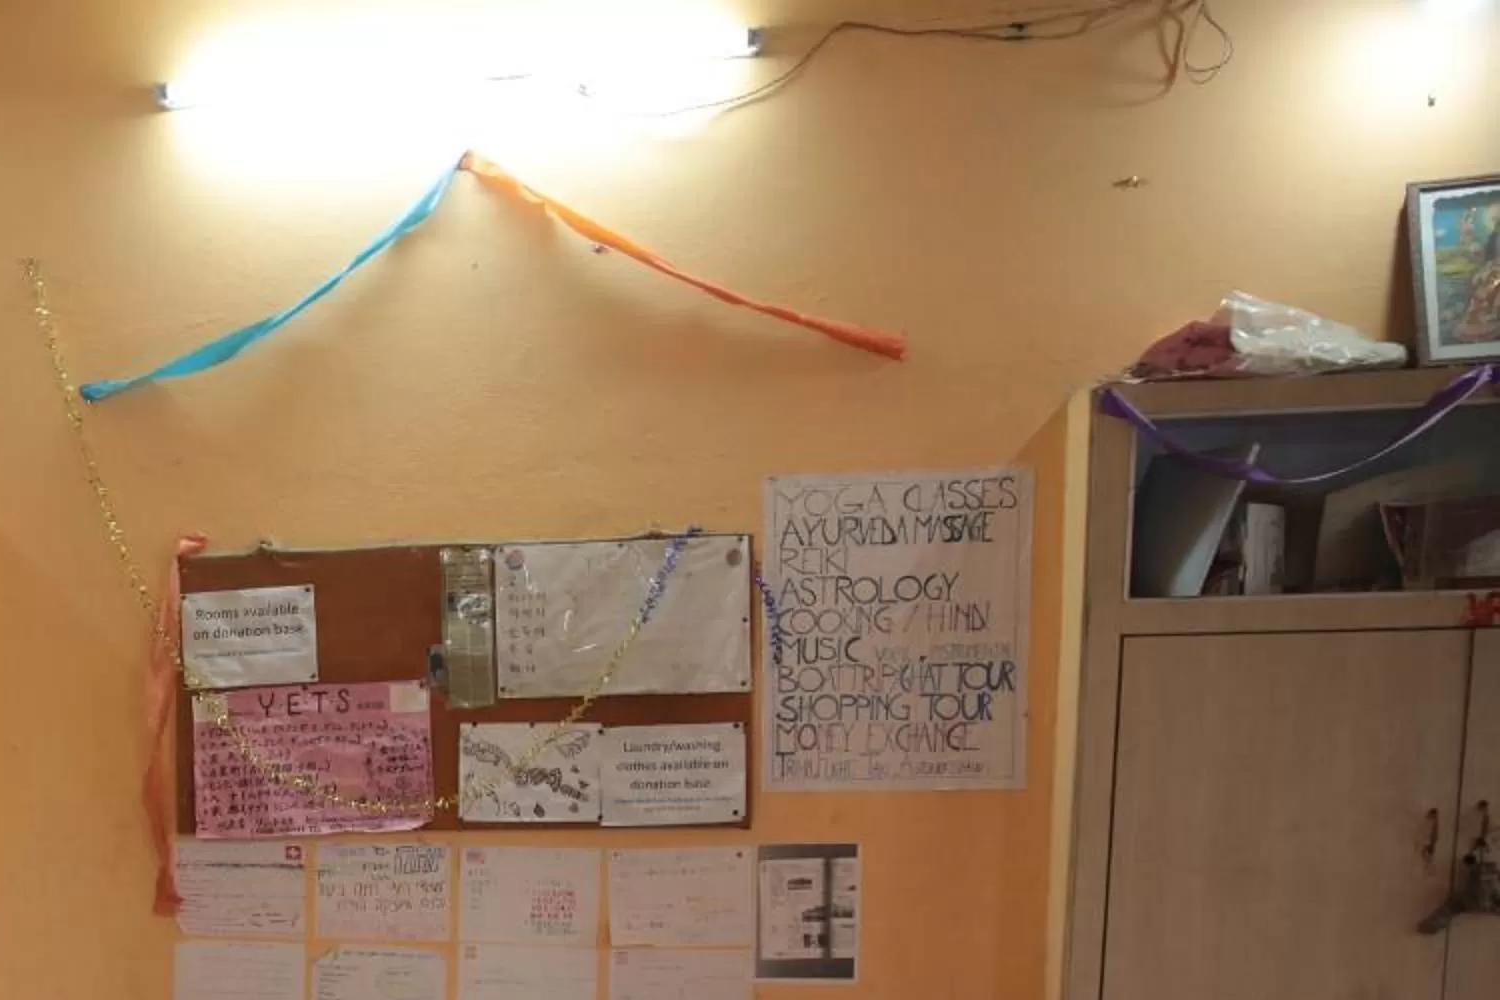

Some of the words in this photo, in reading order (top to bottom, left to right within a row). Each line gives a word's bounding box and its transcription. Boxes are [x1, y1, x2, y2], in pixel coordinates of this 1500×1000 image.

[777, 483, 887, 516] YOGA
[903, 476, 1018, 513] CLASSES
[779, 545, 849, 575] REIKI
[779, 572, 960, 607] ASTROLOGY
[194, 608, 240, 622] Rooms
[776, 605, 893, 637] COOKING
[775, 635, 862, 665] MUSIC
[951, 660, 1016, 693] TOUR
[776, 692, 910, 723] SHOPPING
[919, 691, 993, 722] TOUR
